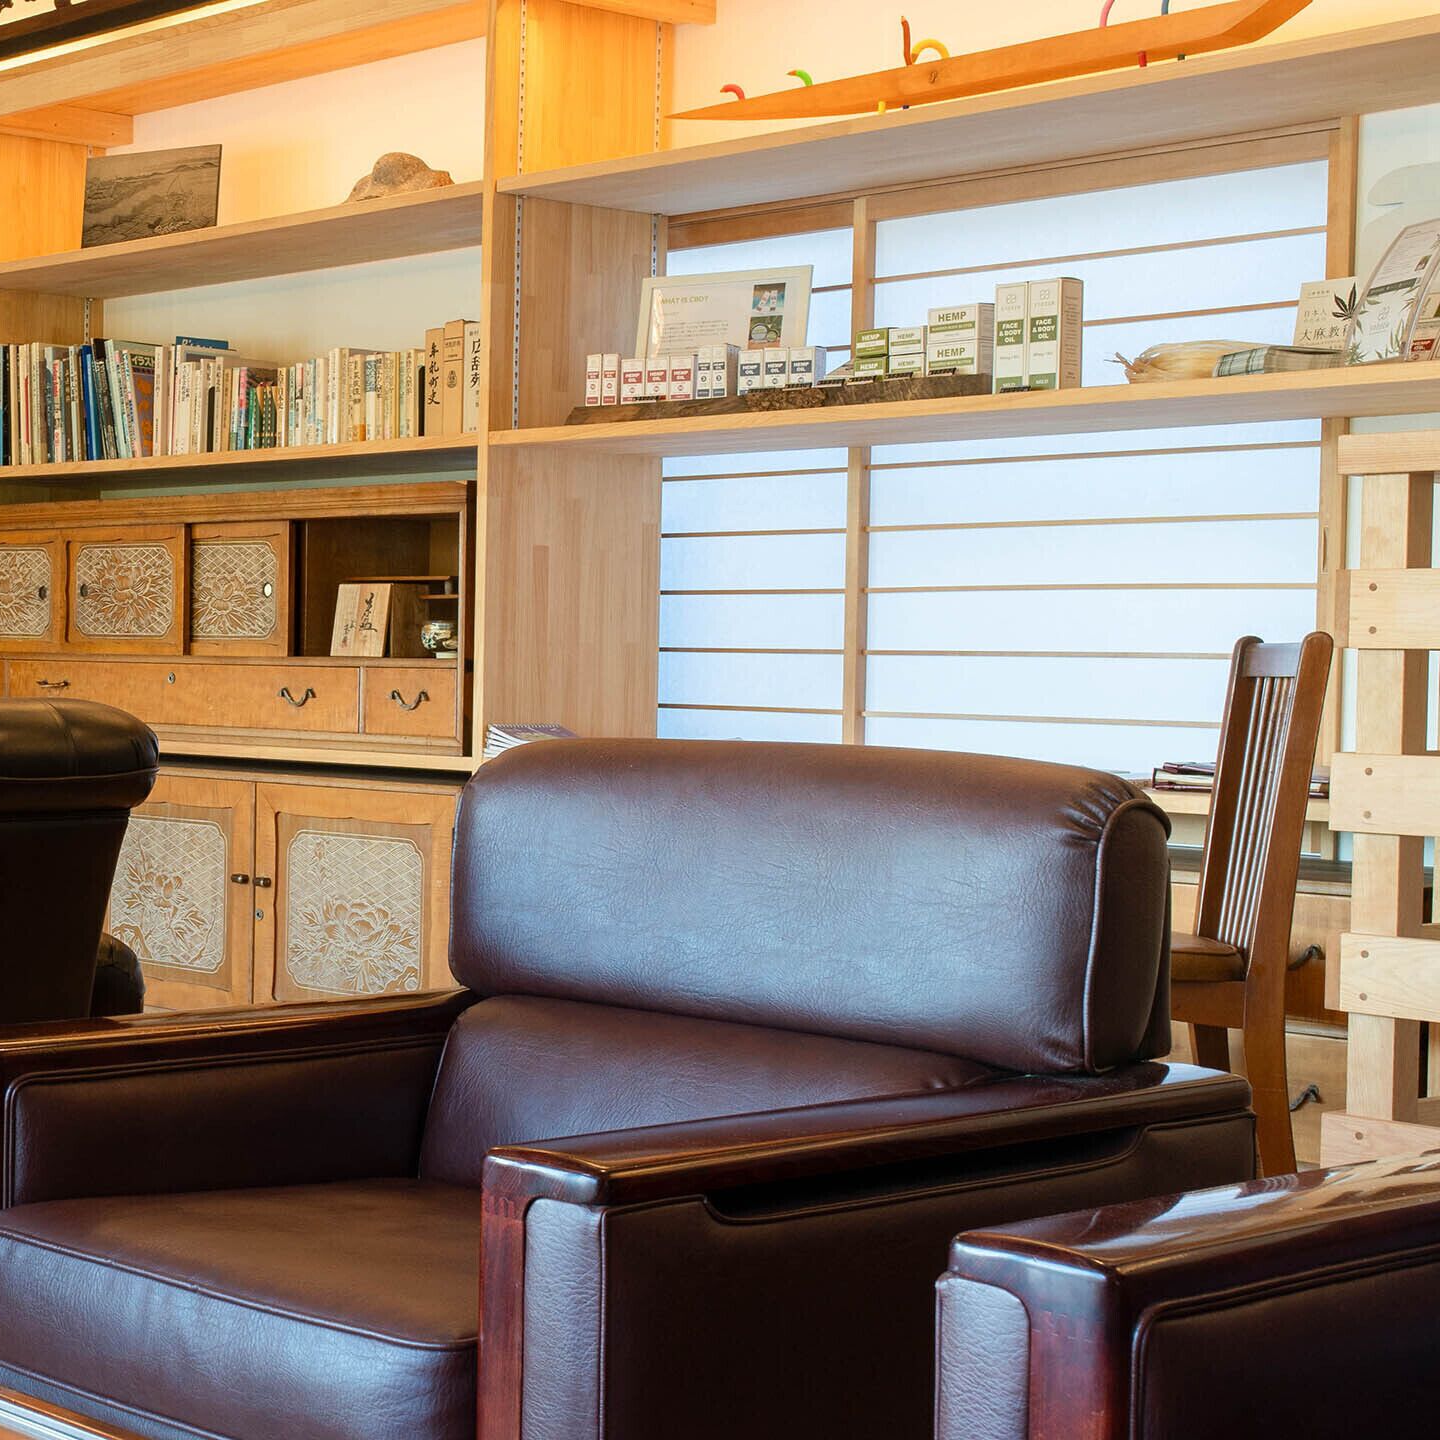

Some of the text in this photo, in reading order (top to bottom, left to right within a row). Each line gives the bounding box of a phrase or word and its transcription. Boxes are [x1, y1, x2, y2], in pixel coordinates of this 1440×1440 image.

[938, 311, 967, 322] HEMP
[1002, 322, 1018, 330] FACE
[1035, 318, 1052, 326] FACE
[936, 347, 966, 358] HEMP
